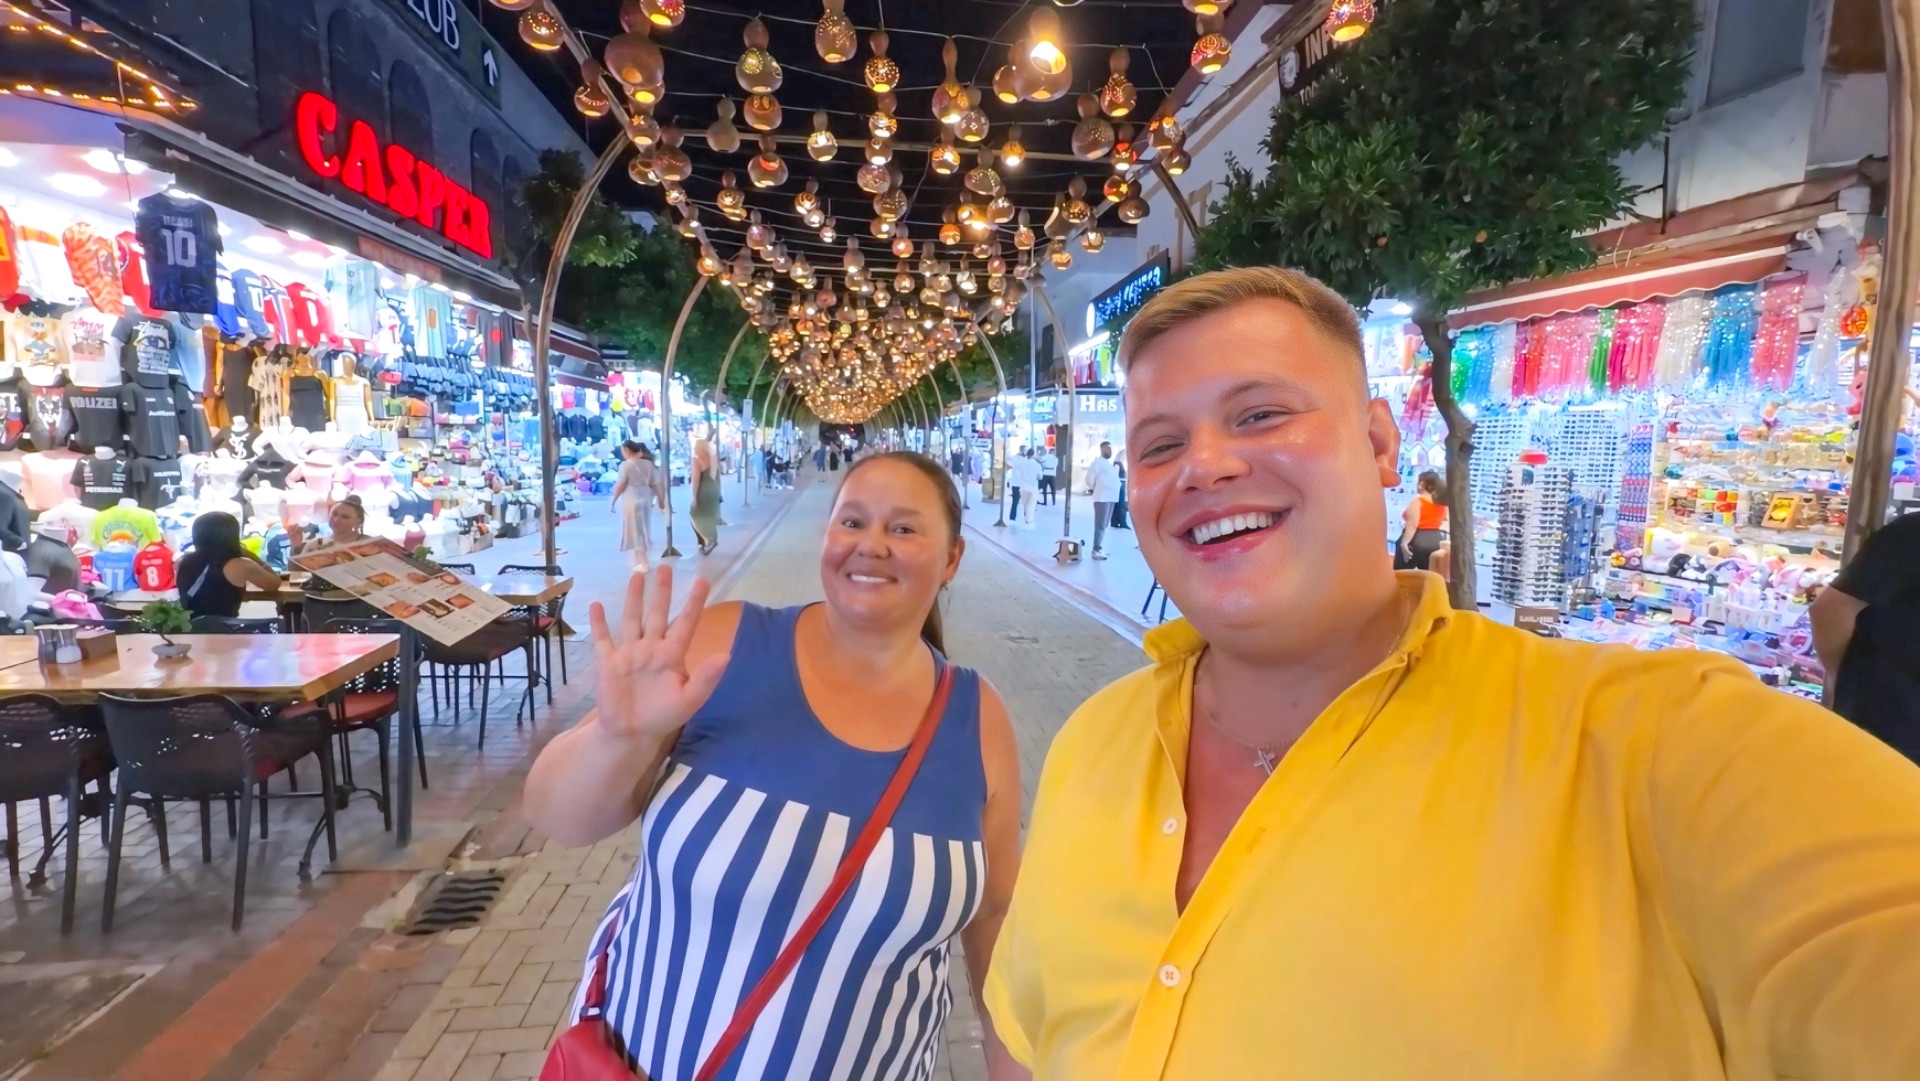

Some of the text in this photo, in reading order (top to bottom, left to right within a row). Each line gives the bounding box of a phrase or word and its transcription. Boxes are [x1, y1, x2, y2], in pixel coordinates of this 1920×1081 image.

[406, 0, 460, 50] UB
[297, 91, 493, 259] CASPER
[160, 227, 197, 268] 10
[103, 568, 125, 592] 11
[146, 566, 160, 588] 8
